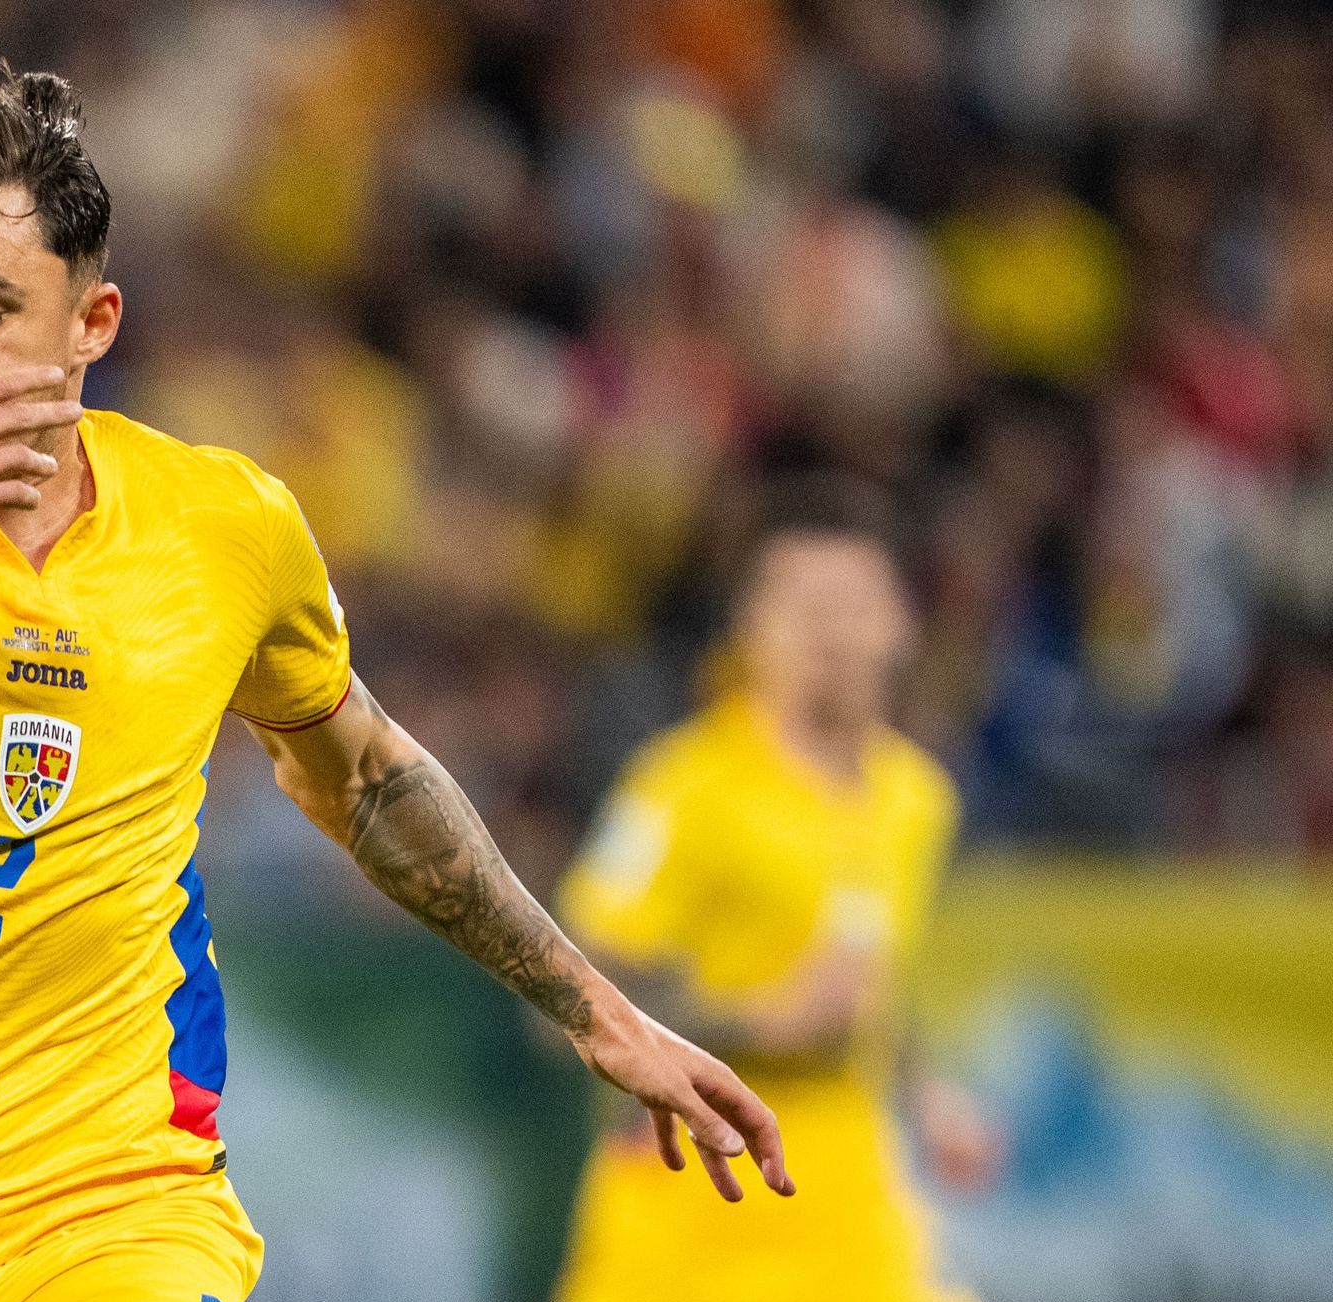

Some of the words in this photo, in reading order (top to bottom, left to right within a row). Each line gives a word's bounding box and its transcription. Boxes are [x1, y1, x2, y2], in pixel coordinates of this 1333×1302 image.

[14, 627, 39, 640] ROU
[55, 629, 78, 643] AUT
[9, 719, 73, 746] ROMÂNIA
